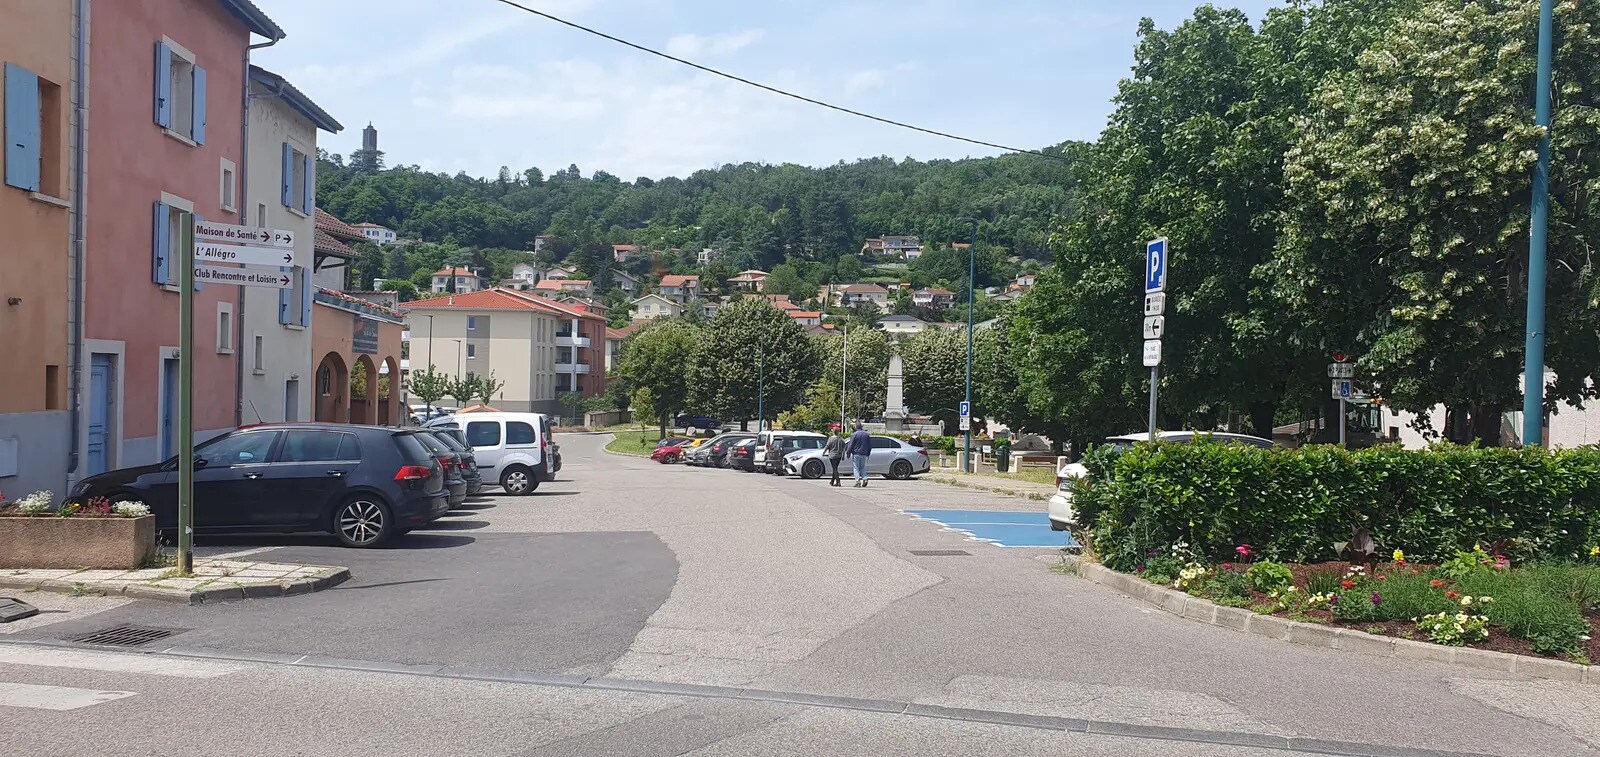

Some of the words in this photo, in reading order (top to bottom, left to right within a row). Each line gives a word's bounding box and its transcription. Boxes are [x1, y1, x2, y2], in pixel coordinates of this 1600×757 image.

[196, 225, 224, 237] Maison
[226, 228, 235, 238] de
[237, 230, 257, 240] Santé
[275, 234, 281, 242] P
[1151, 250, 1160, 282] P
[194, 268, 211, 279] Club
[212, 270, 246, 282] Rencontre
[247, 274, 255, 282] et
[256, 274, 277, 284] Loisirs
[962, 404, 967, 414] P
